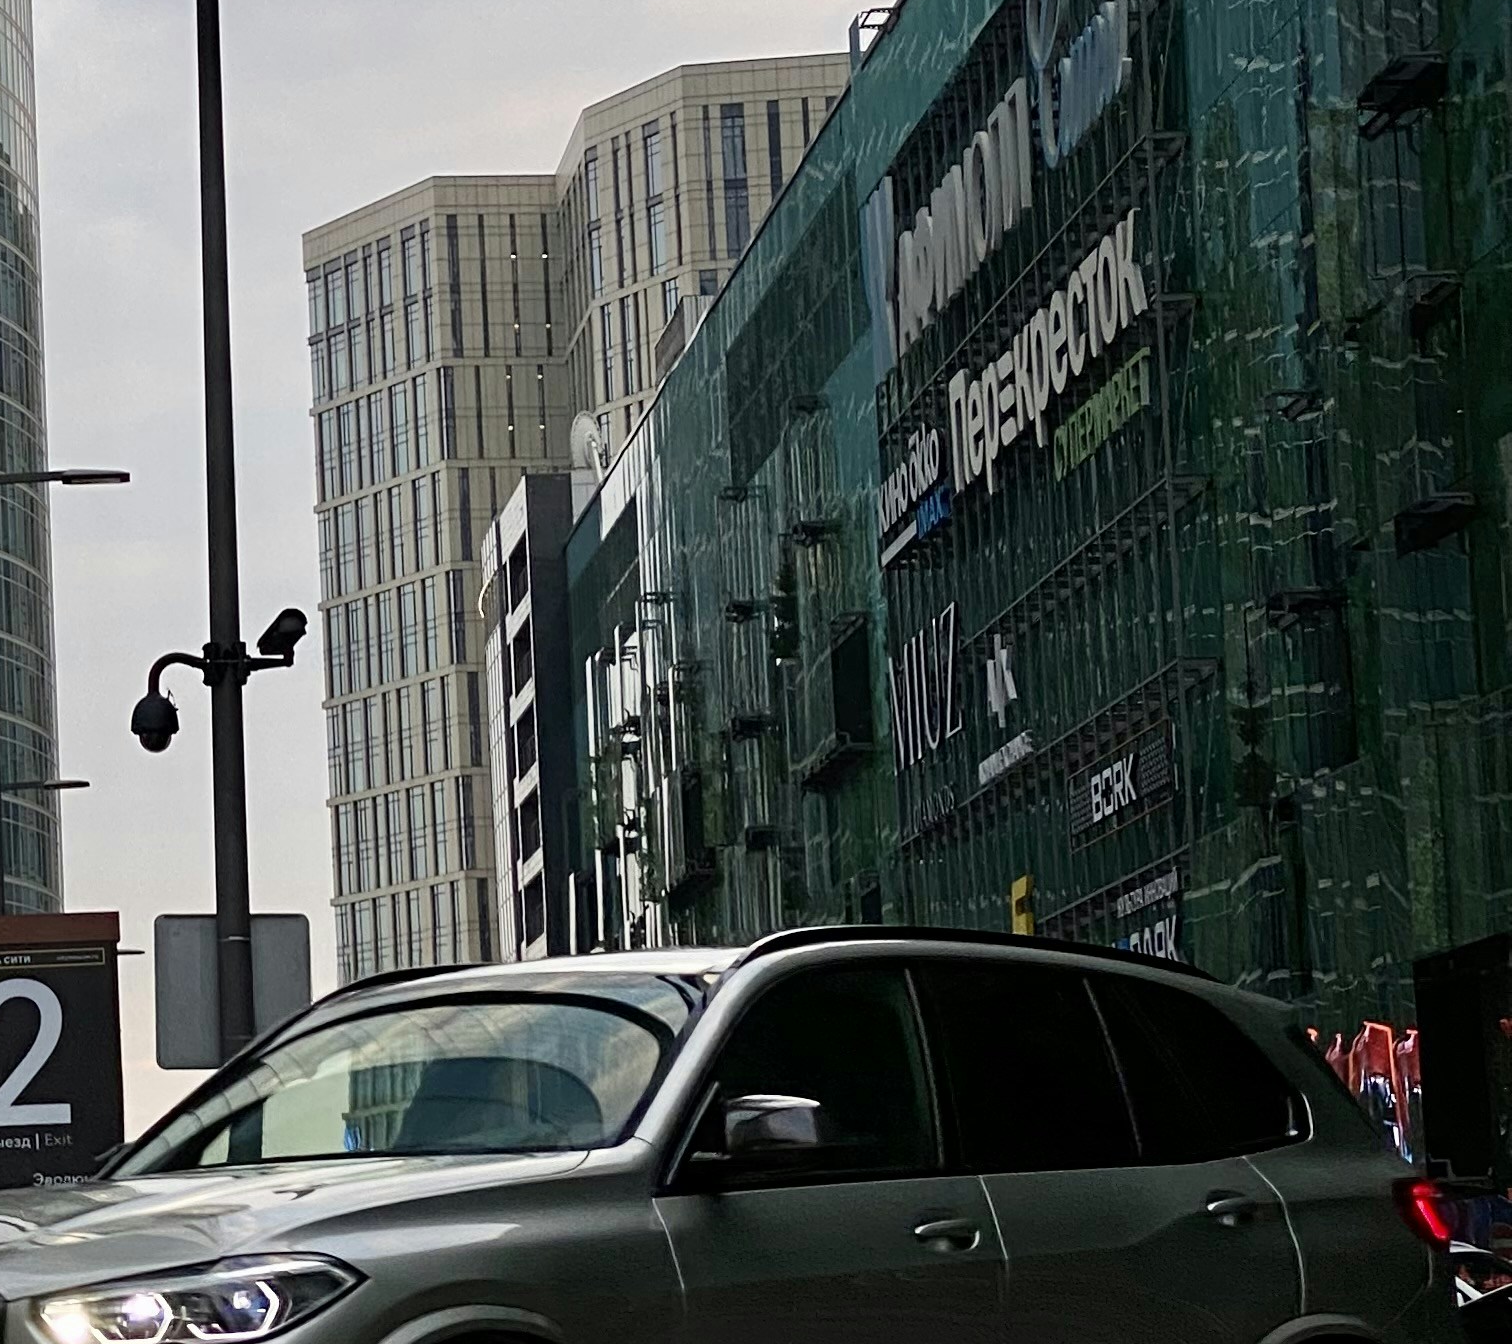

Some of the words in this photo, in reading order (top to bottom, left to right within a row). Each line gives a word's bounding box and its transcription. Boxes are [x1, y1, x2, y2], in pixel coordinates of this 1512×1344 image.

[889, 602, 962, 776] MIUZ
[1091, 753, 1137, 823] BORK
[4, 955, 31, 965] СИТИ
[44, 1133, 73, 1147] Exit
